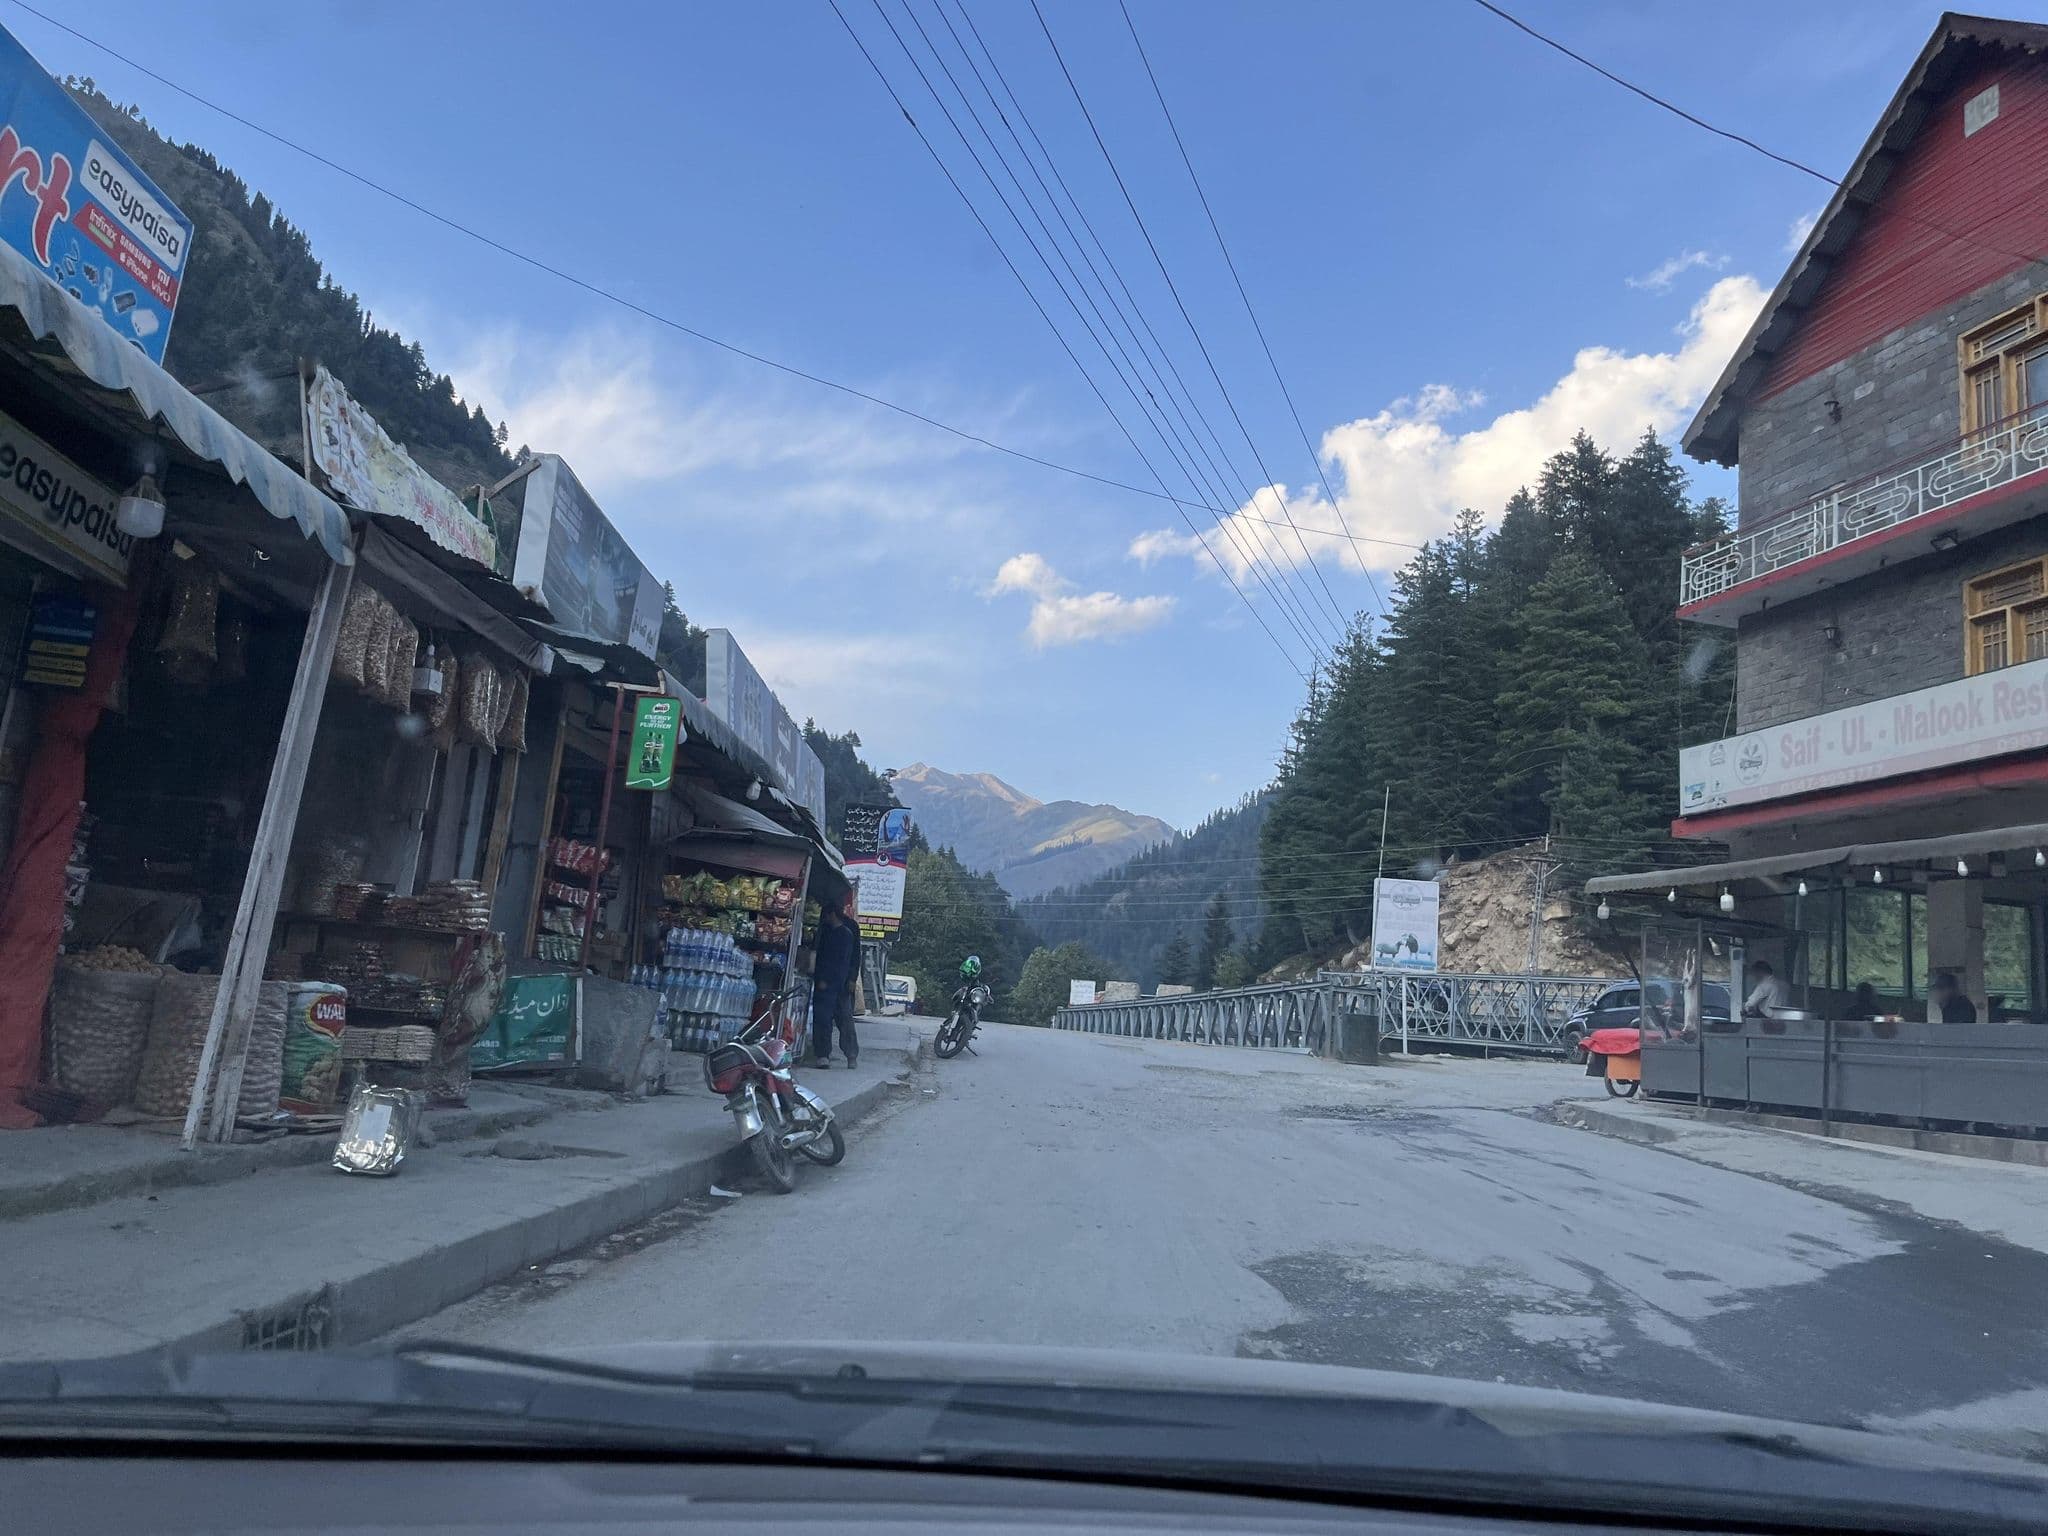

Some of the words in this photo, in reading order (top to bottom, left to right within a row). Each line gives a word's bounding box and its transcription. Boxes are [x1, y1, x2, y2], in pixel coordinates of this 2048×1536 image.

[89, 156, 180, 257] easypaisa
[120, 235, 152, 269] SAMSUNG
[1780, 724, 1820, 769] Saif
[1842, 714, 1872, 756] UL
[1893, 689, 1983, 745] Malook
